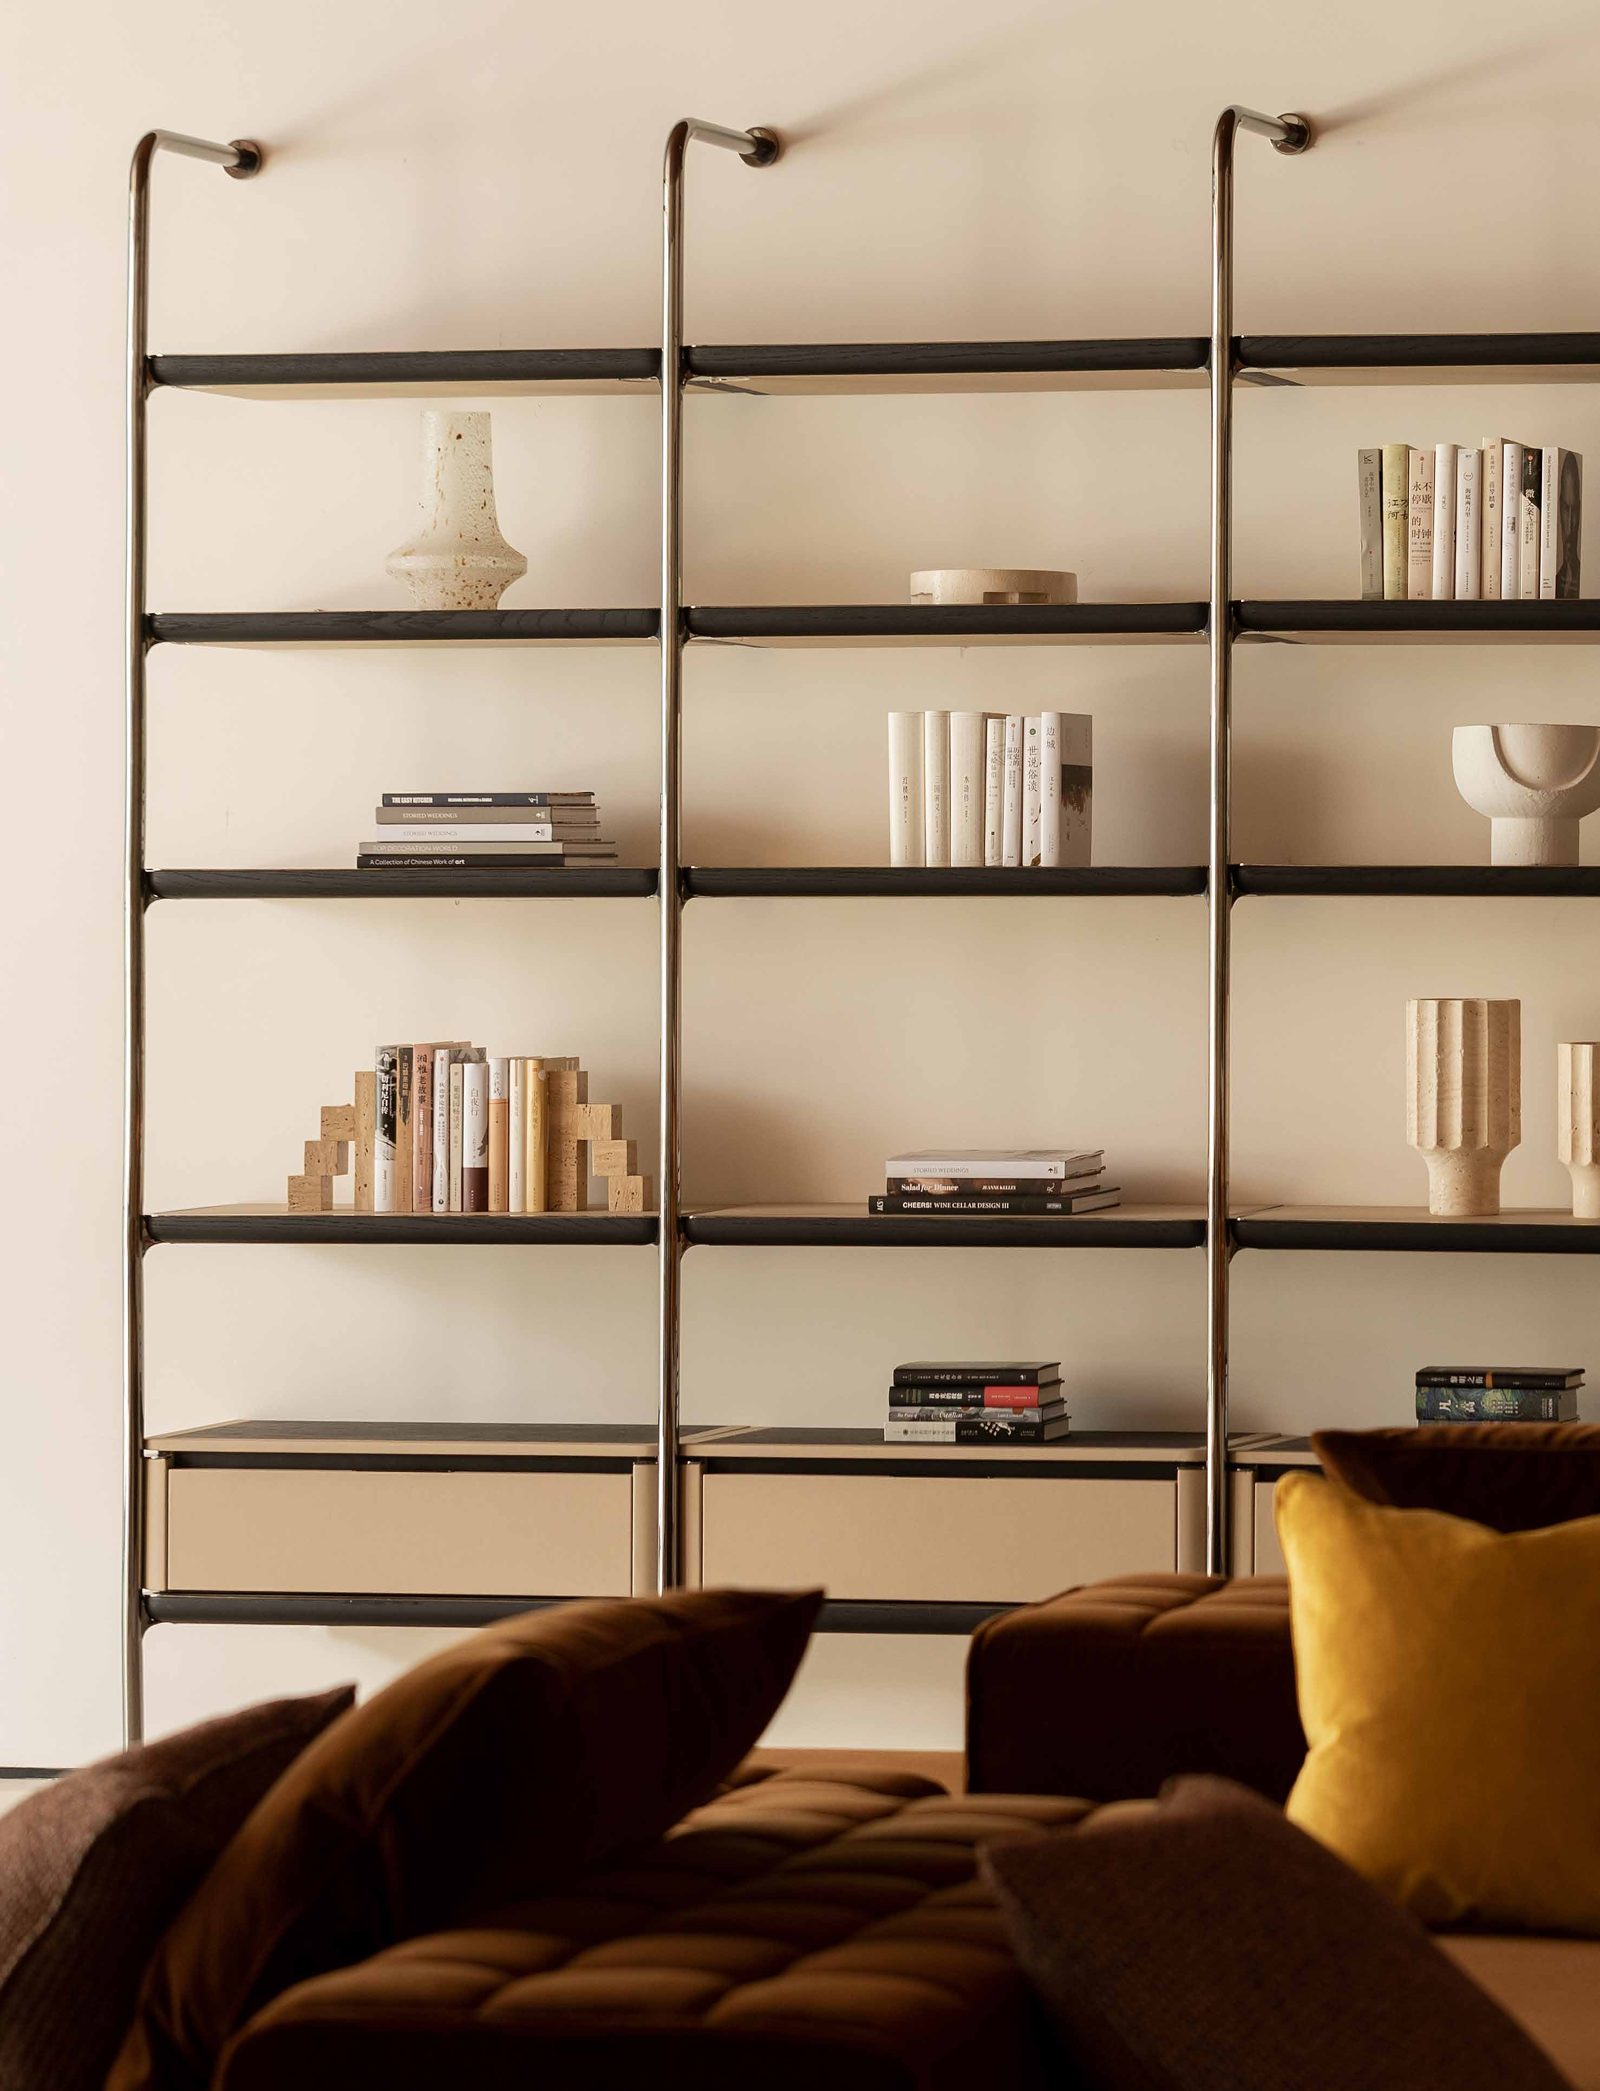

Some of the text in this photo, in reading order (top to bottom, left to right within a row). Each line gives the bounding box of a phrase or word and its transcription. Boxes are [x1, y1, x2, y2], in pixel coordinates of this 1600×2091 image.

[1412, 481, 1432, 491] 永不
[1411, 516, 1421, 526] 的
[1411, 529, 1432, 539] 时钟
[1046, 726, 1055, 750] 边城
[1027, 745, 1039, 792] 世说俗谈
[471, 1087, 480, 1118] 白夜行
[920, 1184, 931, 1192] for
